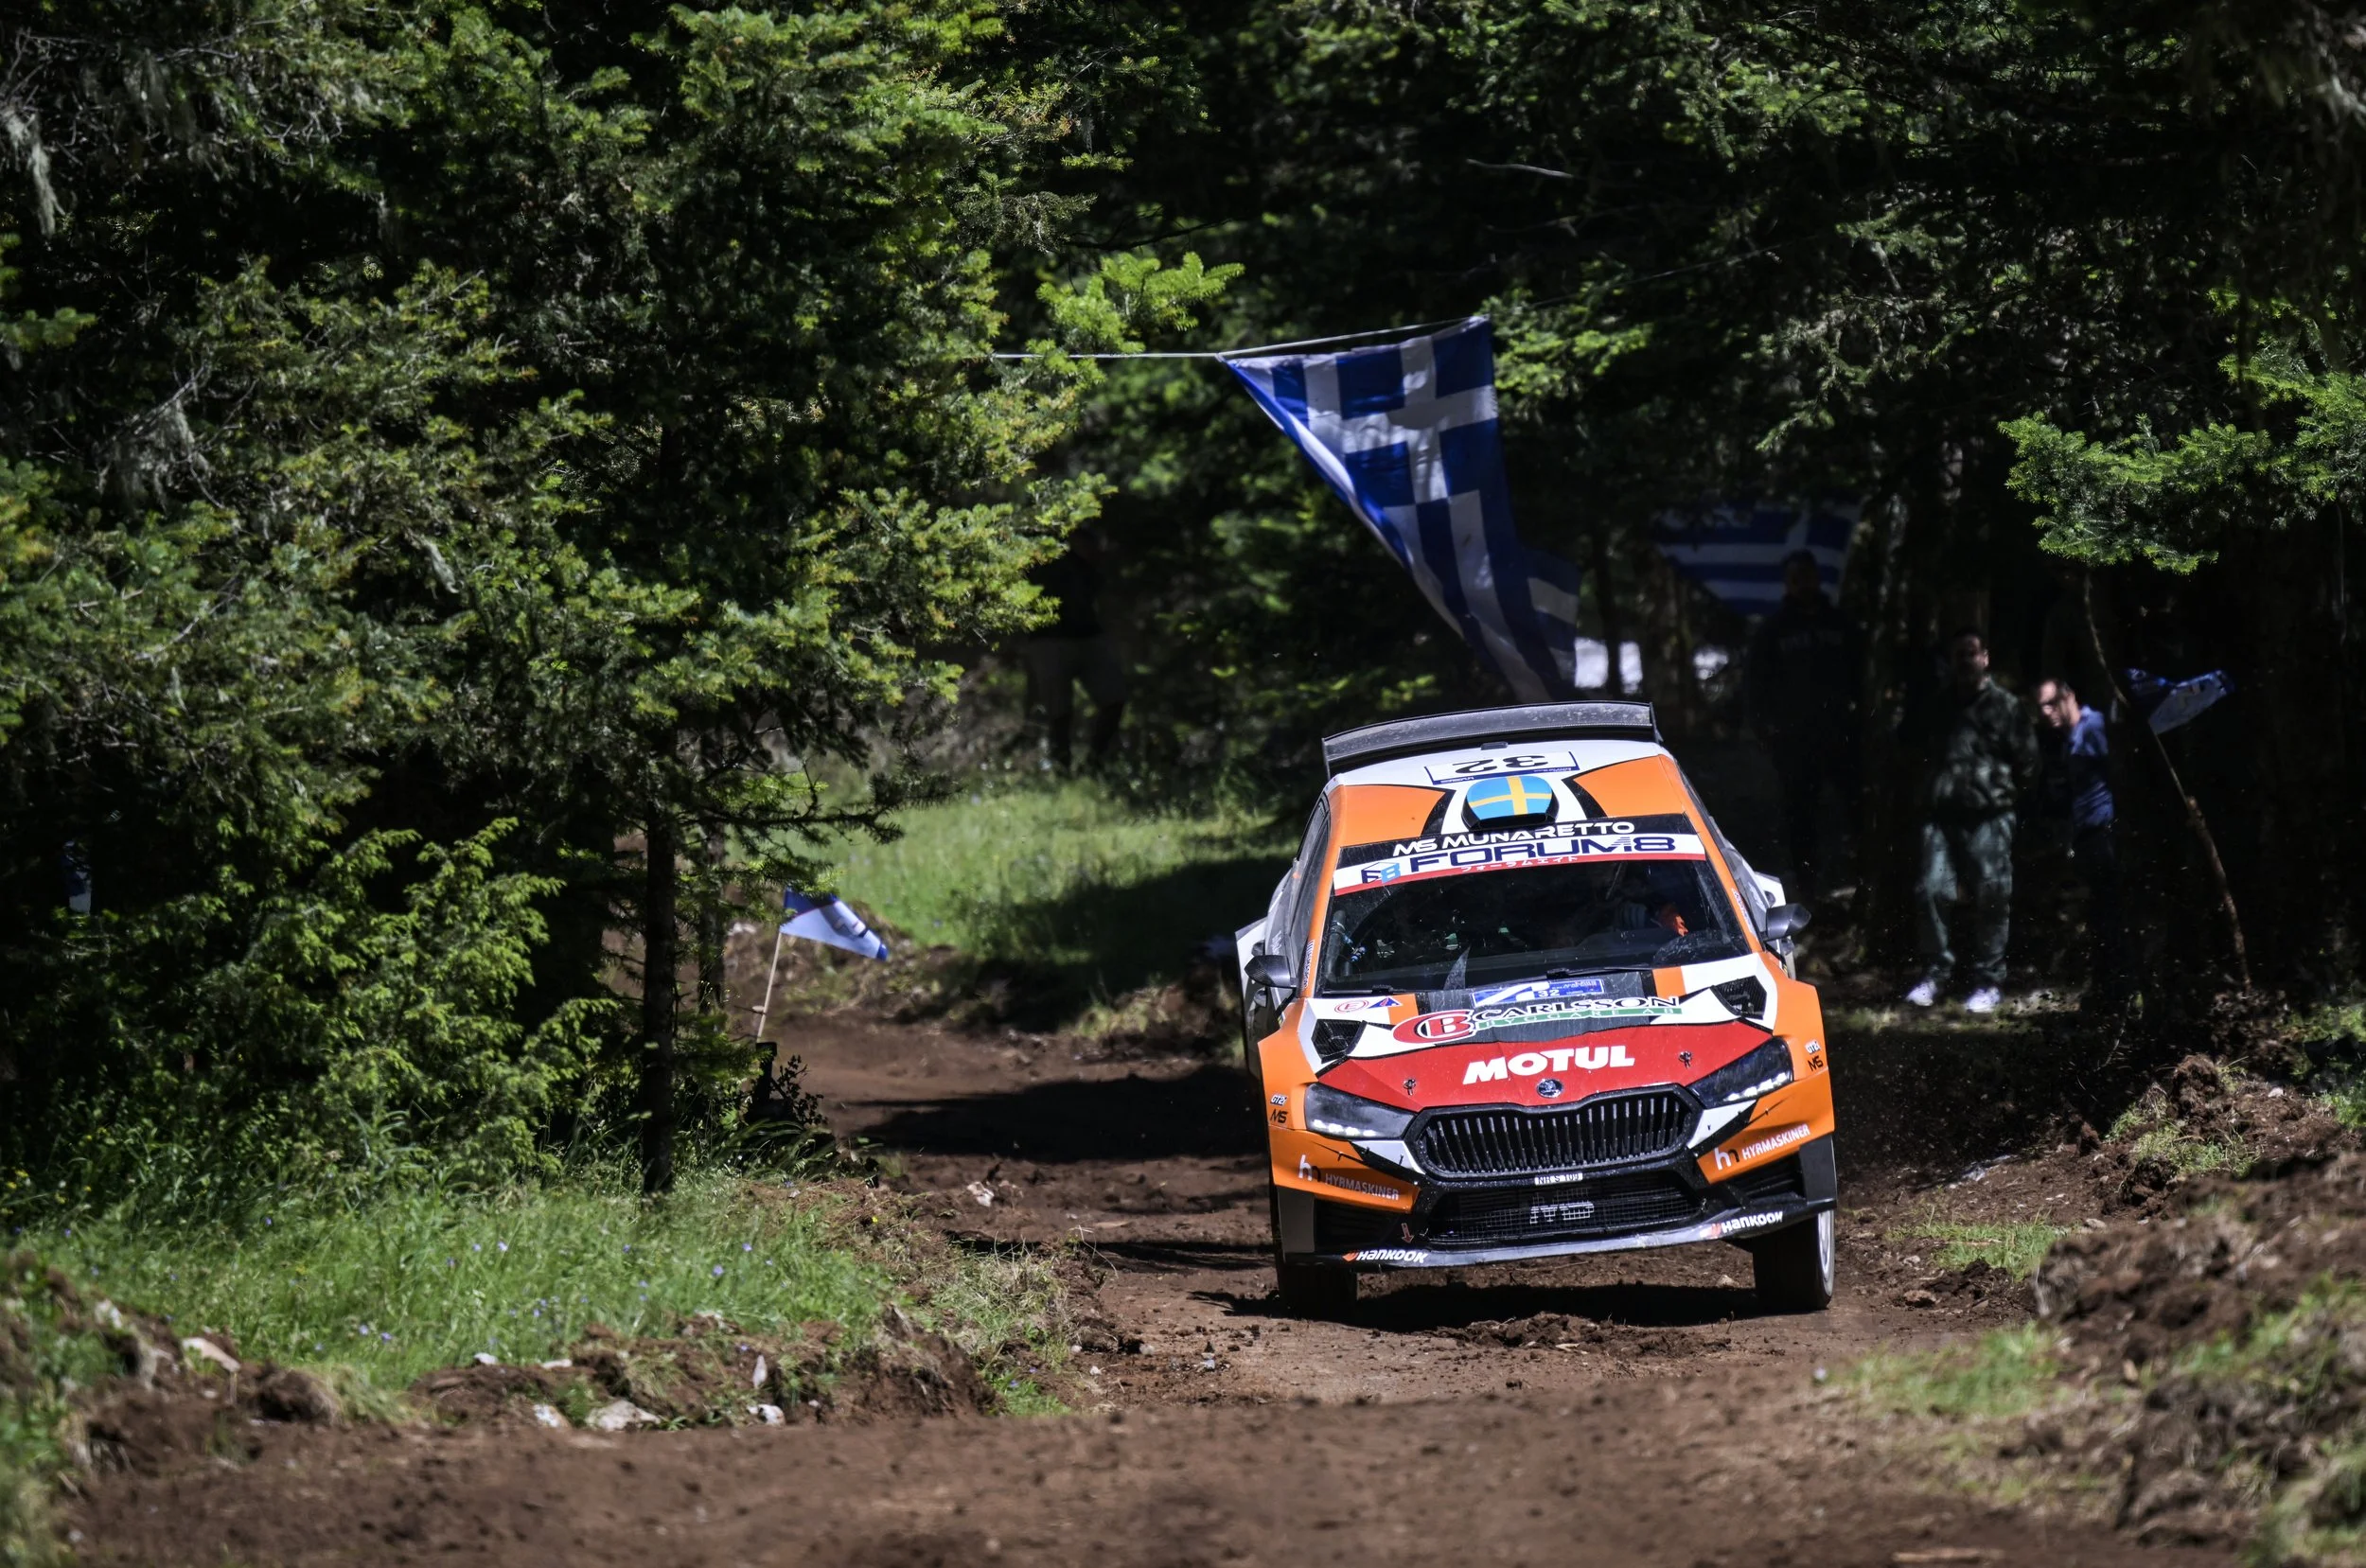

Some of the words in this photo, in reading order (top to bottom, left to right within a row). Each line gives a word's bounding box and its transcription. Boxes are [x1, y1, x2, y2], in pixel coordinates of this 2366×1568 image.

[1452, 755, 1548, 774] 32
[1392, 837, 1439, 857] MS
[1441, 820, 1635, 850] MUNARETTO
[1409, 837, 1676, 873] FORUM8
[1460, 855, 1579, 872] フォーラムエイト
[1537, 989, 1561, 998] 32
[1472, 995, 1680, 1022] CARLSSON
[1642, 1006, 1674, 1015] AB
[1462, 1045, 1636, 1085] MOTUL
[1269, 1108, 1288, 1124] MS
[1741, 1123, 1811, 1161] HYRMASKINER
[1325, 1172, 1400, 1202] HYRMASKINER
